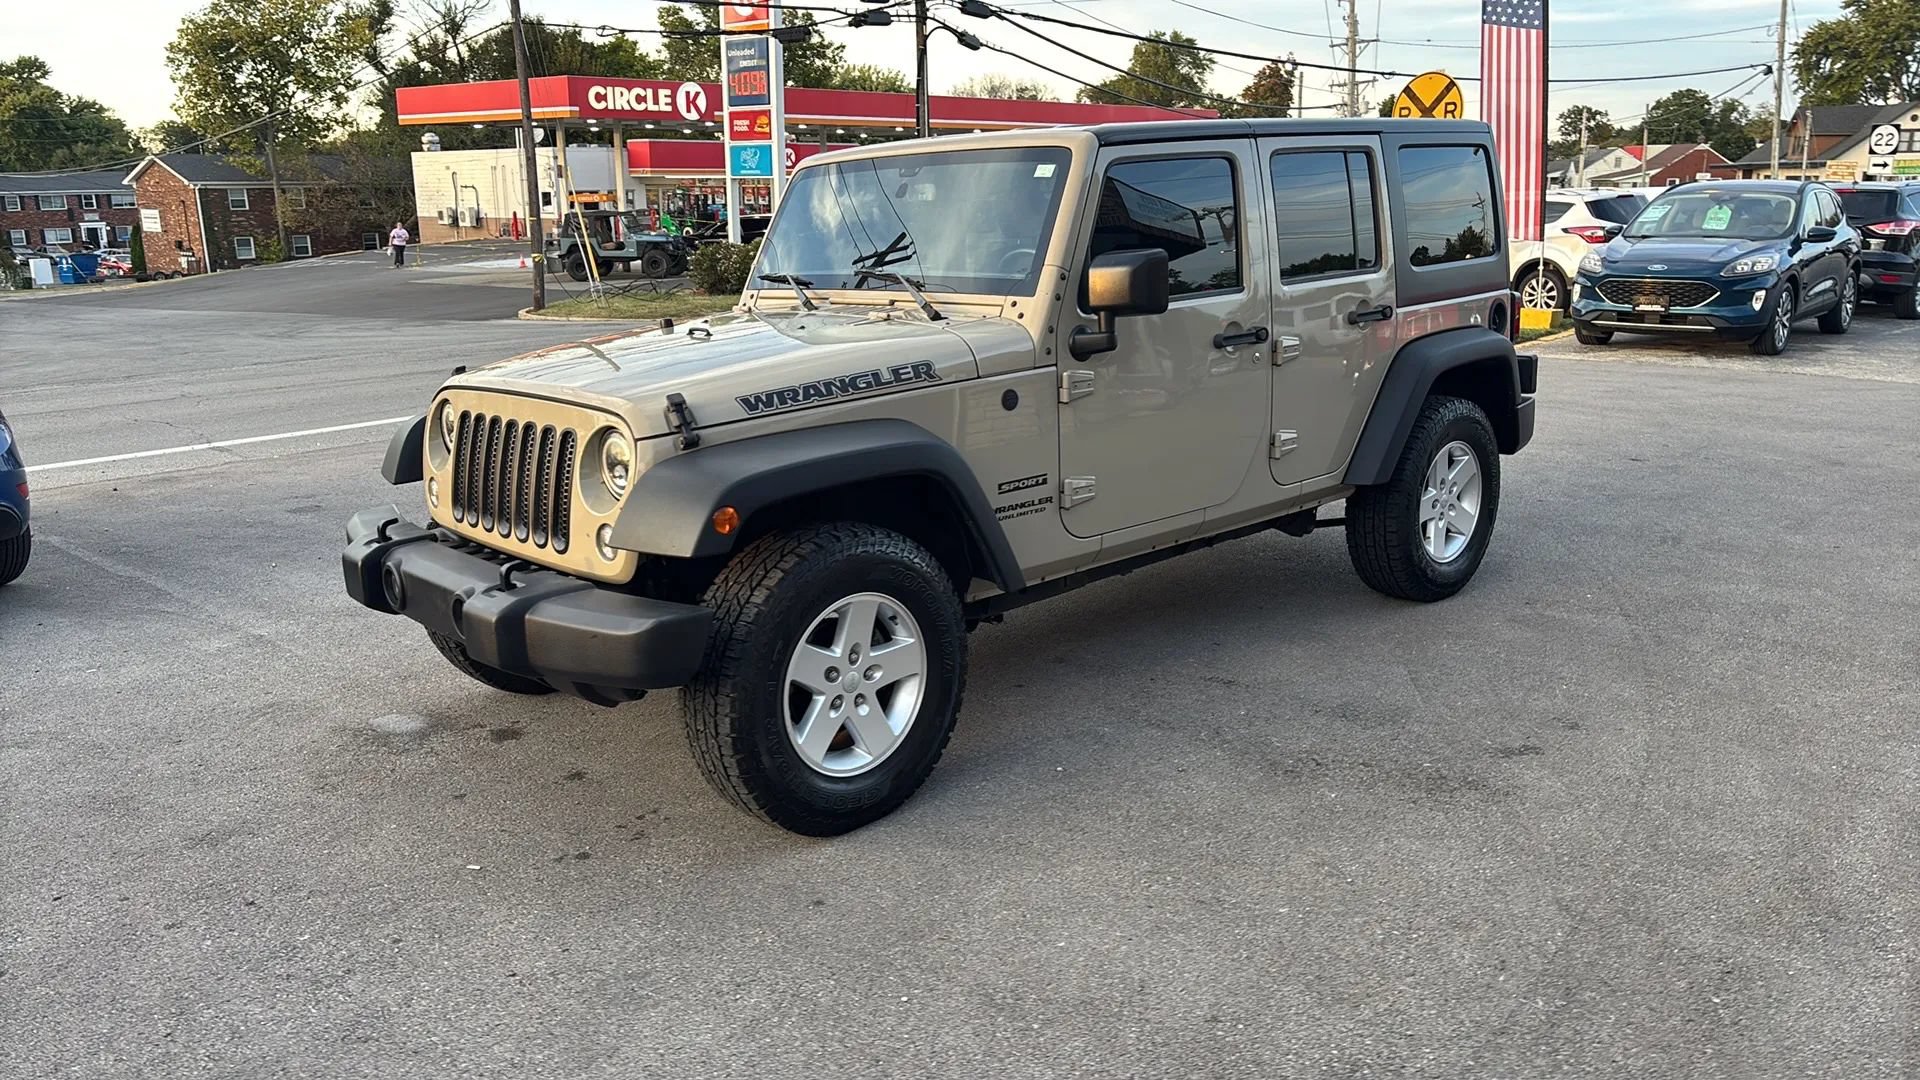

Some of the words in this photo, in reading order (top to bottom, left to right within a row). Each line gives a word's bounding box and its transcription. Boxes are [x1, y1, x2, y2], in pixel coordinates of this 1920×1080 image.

[728, 48, 755, 57] Unleaded
[588, 85, 672, 112] CIRCLE
[1444, 102, 1457, 119] R
[1874, 133, 1895, 147] 22
[737, 360, 942, 414] WRANGLER
[998, 475, 1047, 491] SPORT
[998, 507, 1046, 521] UNLIMITED
